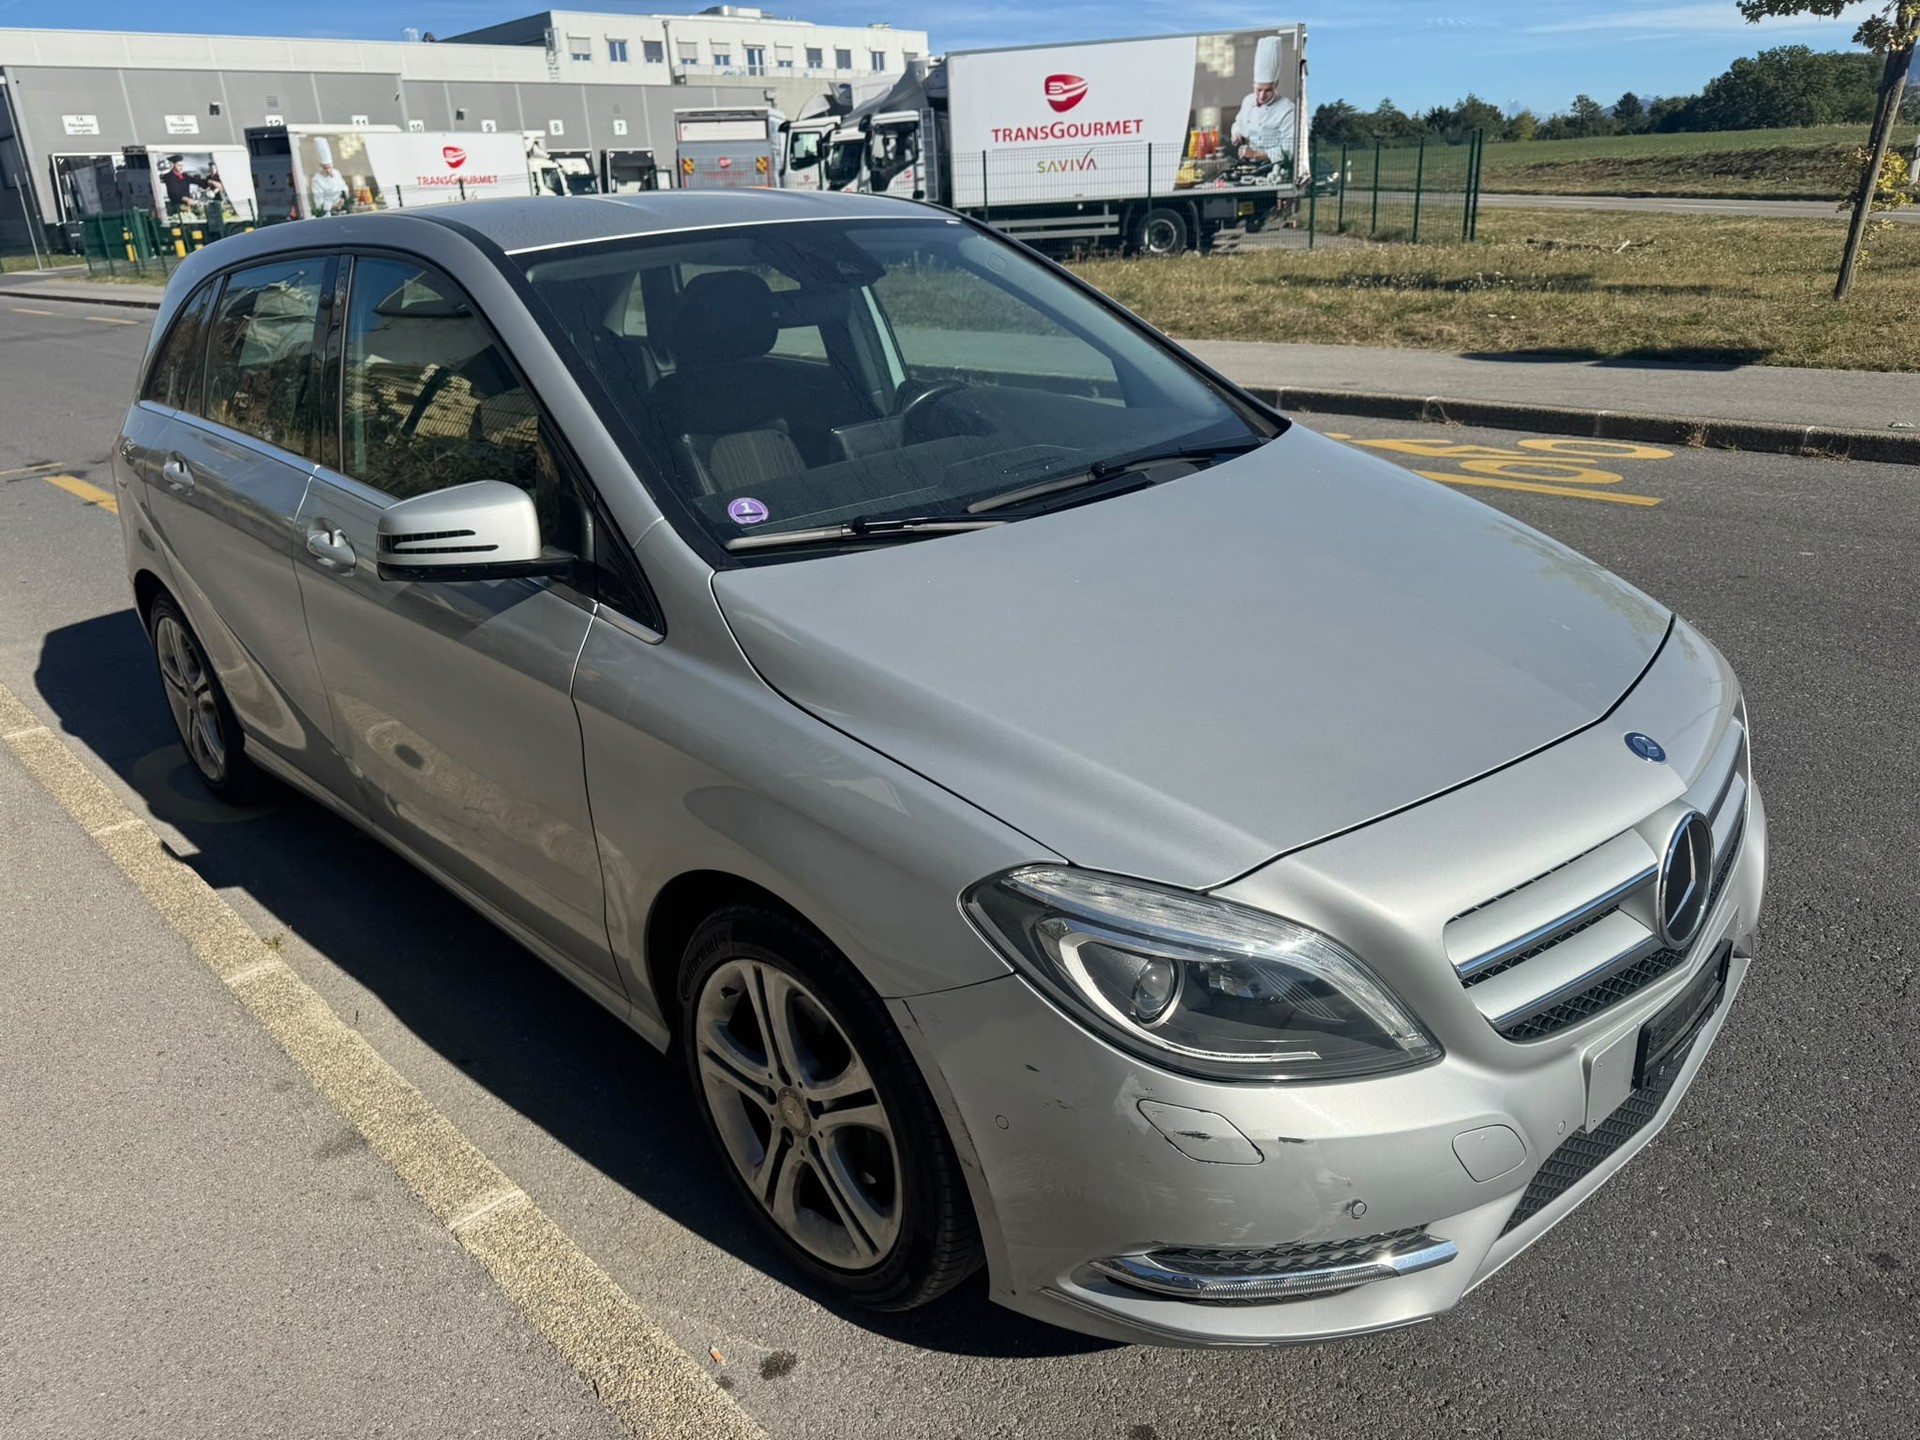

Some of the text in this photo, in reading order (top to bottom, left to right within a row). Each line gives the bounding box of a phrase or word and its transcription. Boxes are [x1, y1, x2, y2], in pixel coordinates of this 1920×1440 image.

[617, 122, 624, 132] 7
[992, 119, 1143, 142] TRANSGOURMET
[1036, 149, 1097, 173] SAVIVA
[741, 502, 753, 513] 1
